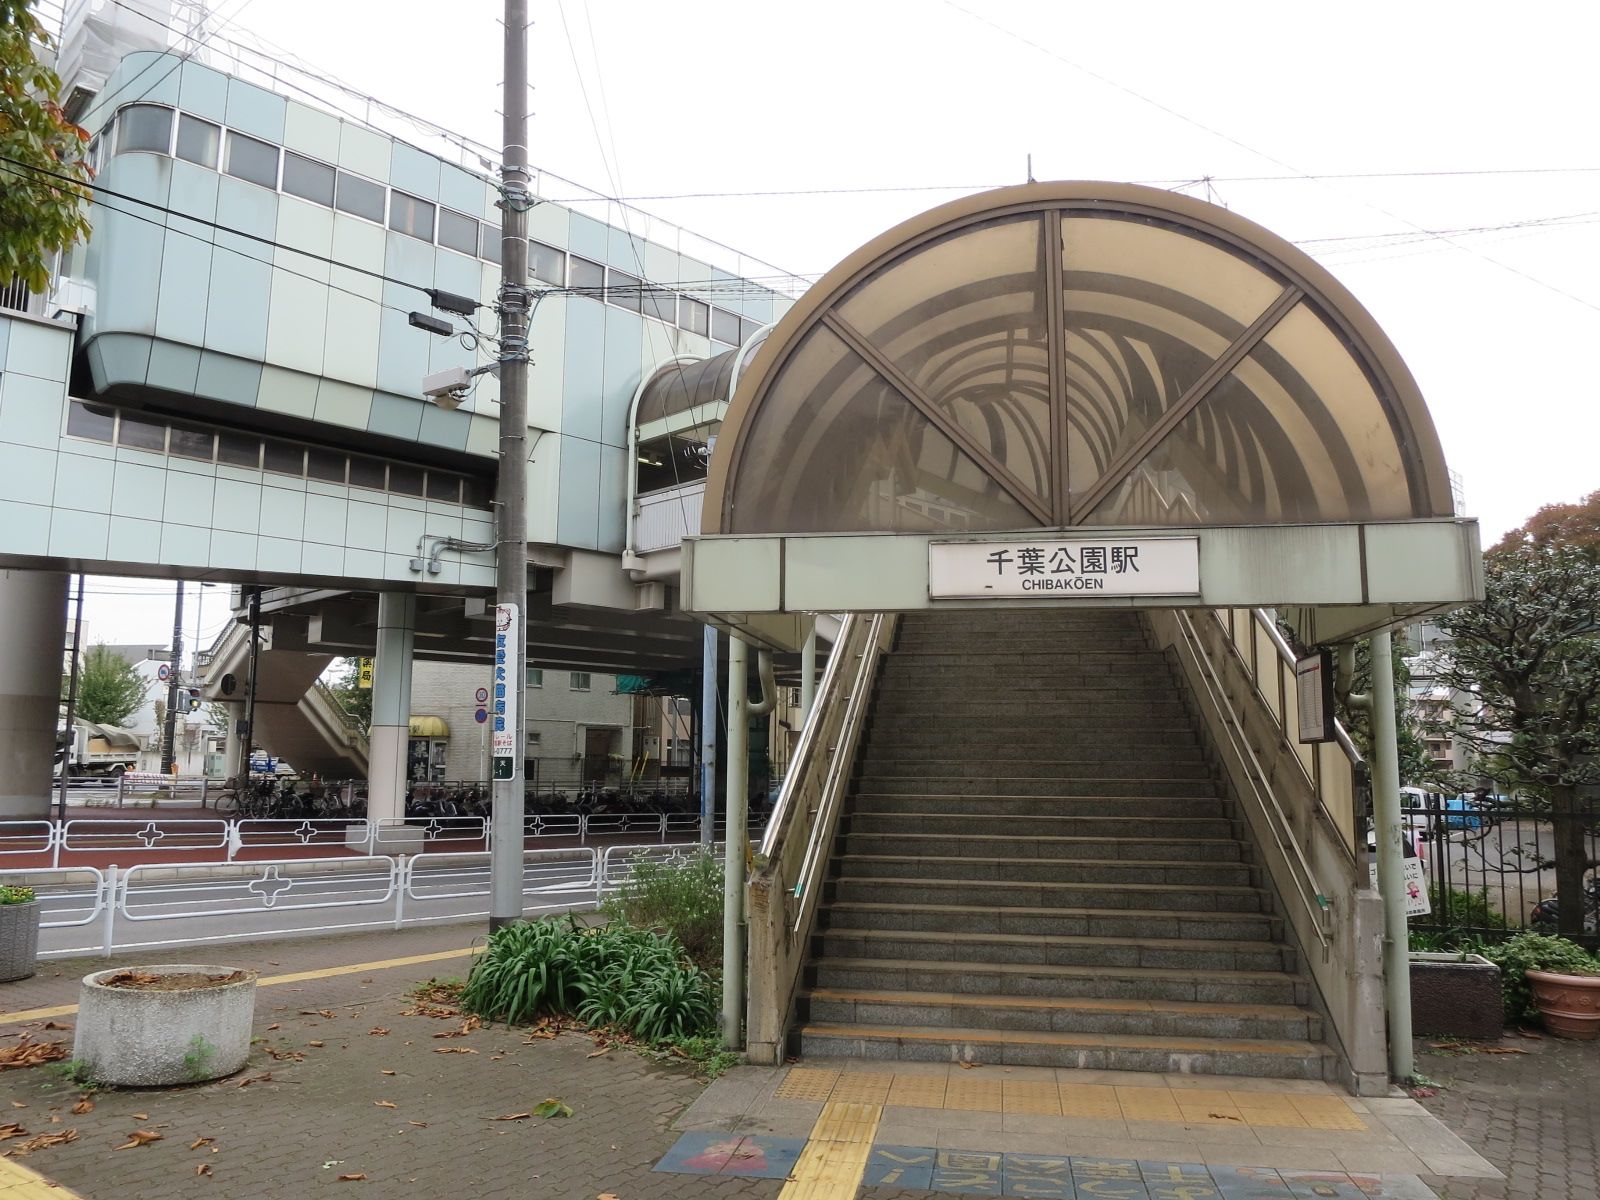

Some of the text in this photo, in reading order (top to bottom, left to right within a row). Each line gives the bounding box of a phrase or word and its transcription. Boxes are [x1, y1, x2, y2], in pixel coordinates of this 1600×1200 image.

[987, 546, 1140, 576] 千葉公園駅
[1022, 577, 1104, 591] CHIBAKŌEN
